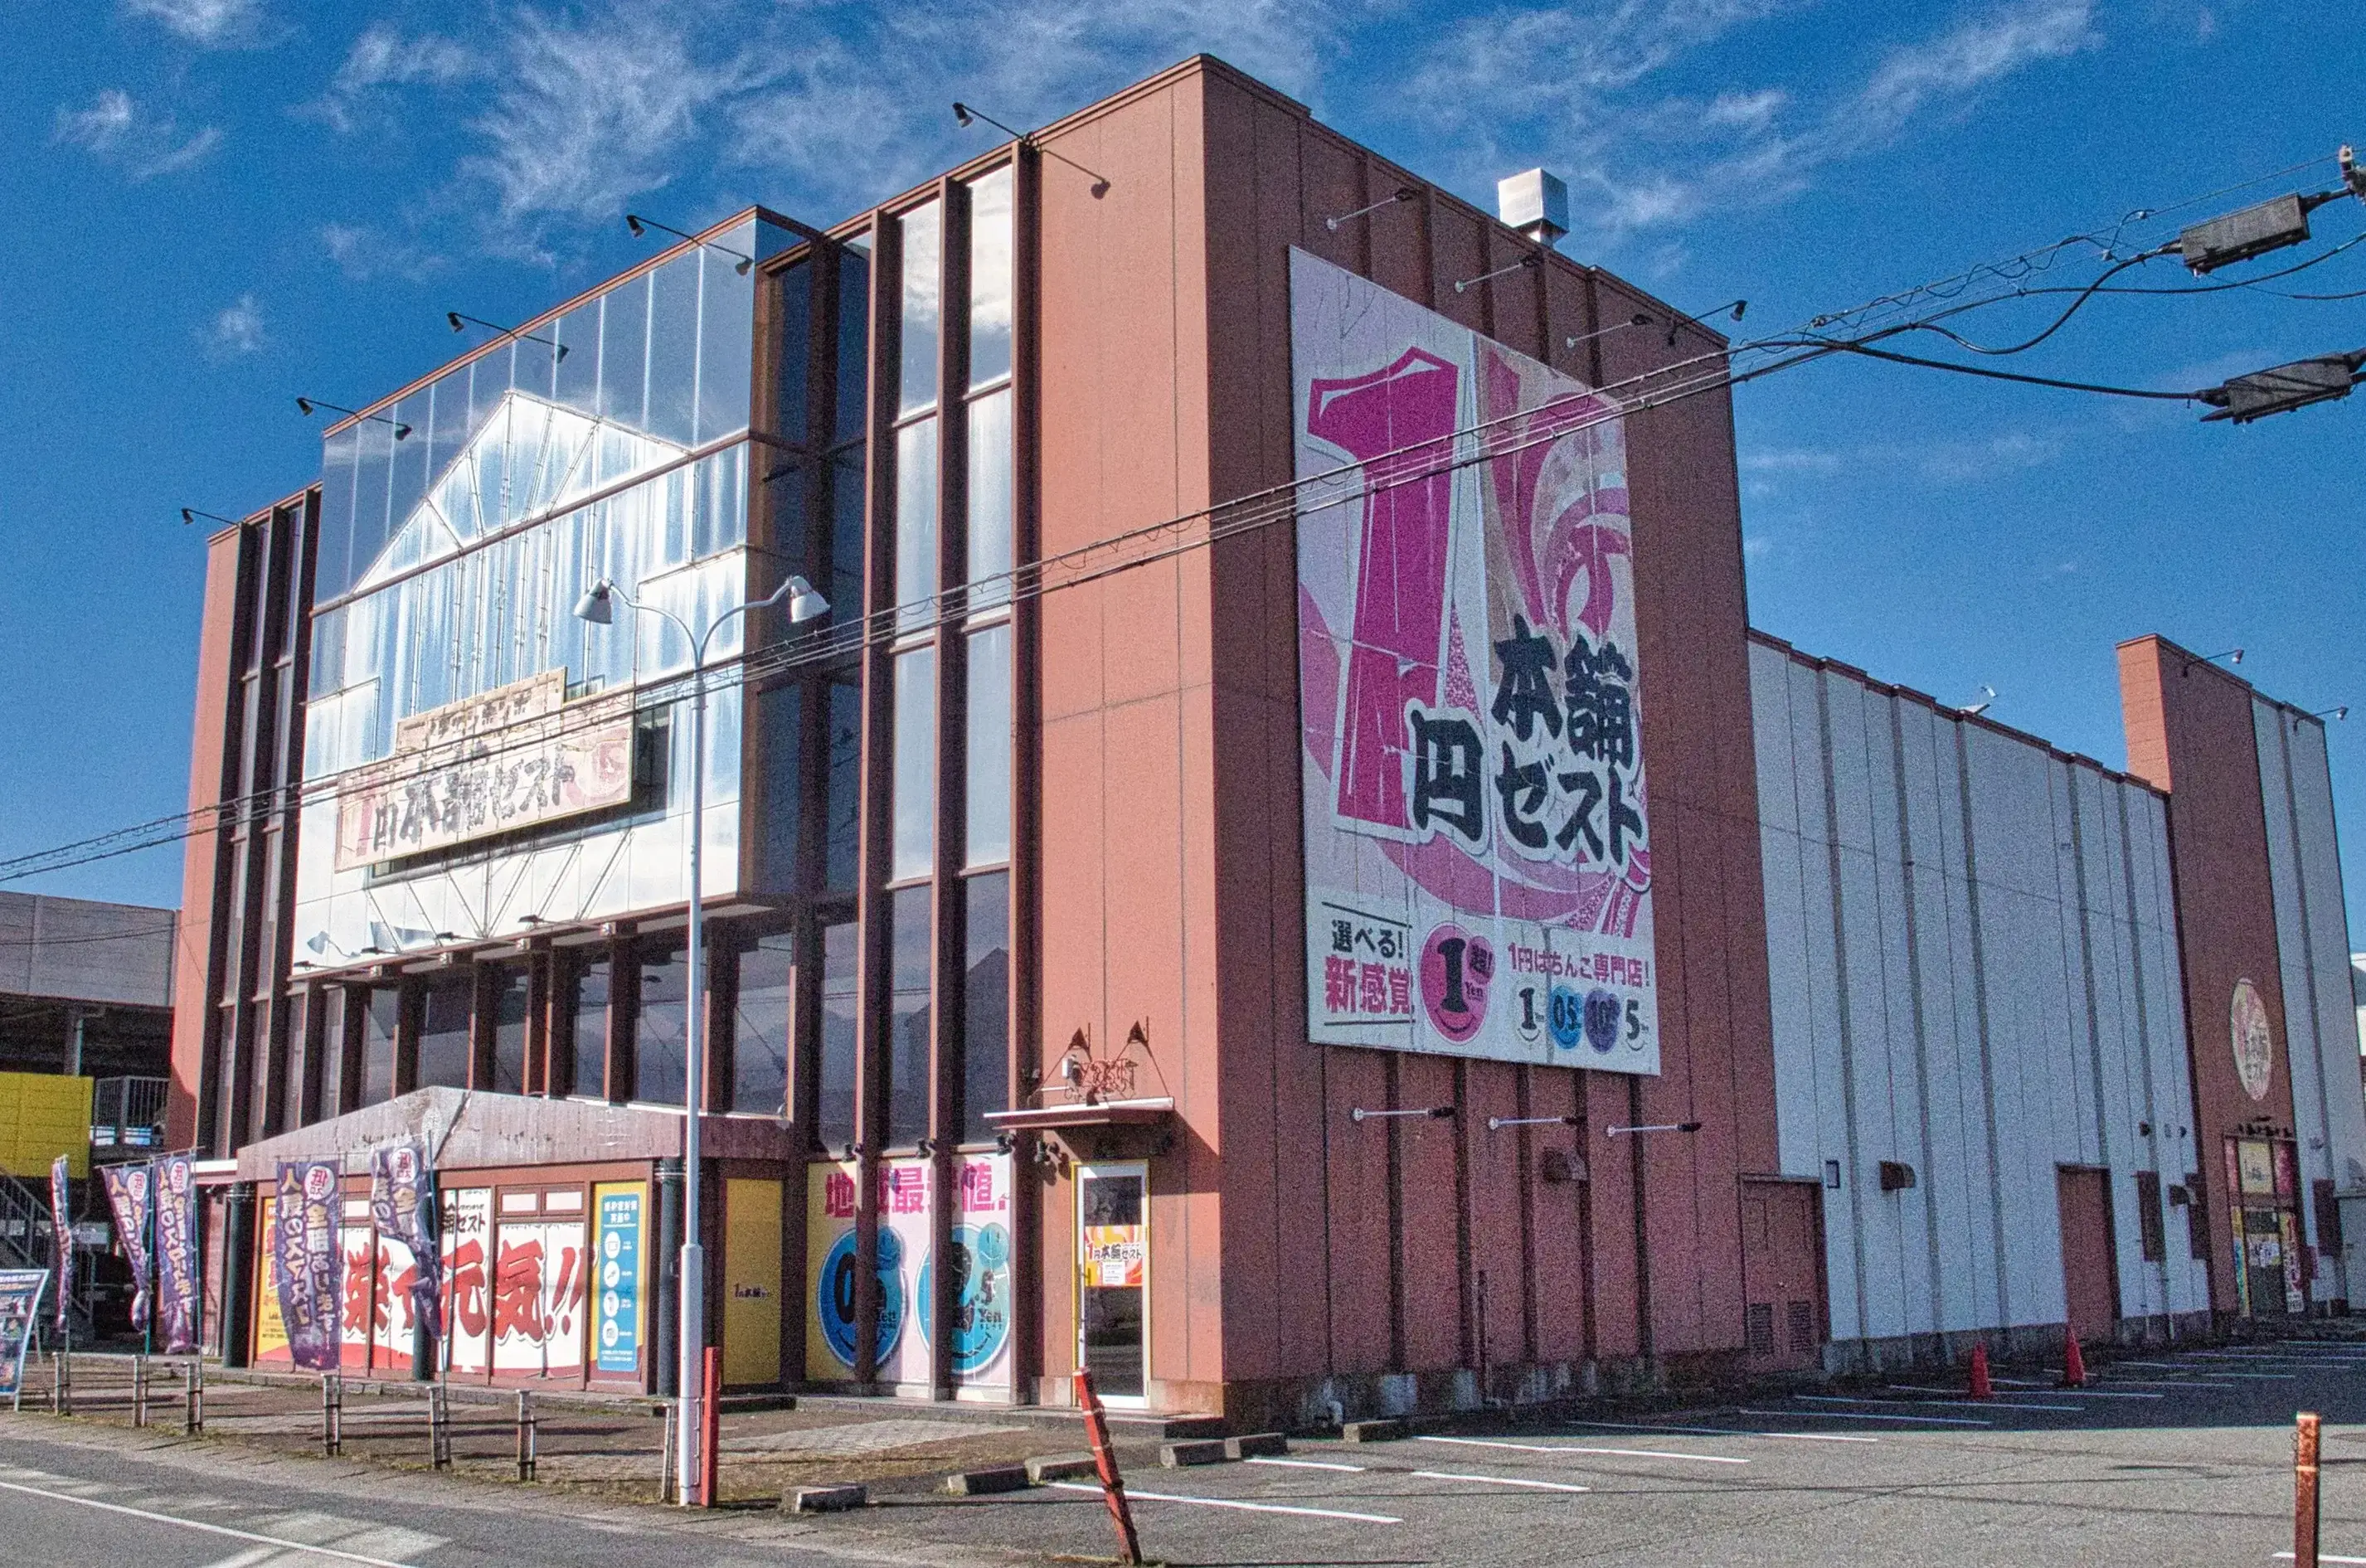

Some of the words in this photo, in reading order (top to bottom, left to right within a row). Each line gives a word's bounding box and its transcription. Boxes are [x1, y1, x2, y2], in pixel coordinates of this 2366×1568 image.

[1496, 746, 1643, 867] ゼスト
[1325, 954, 1414, 1014] 新感覚
